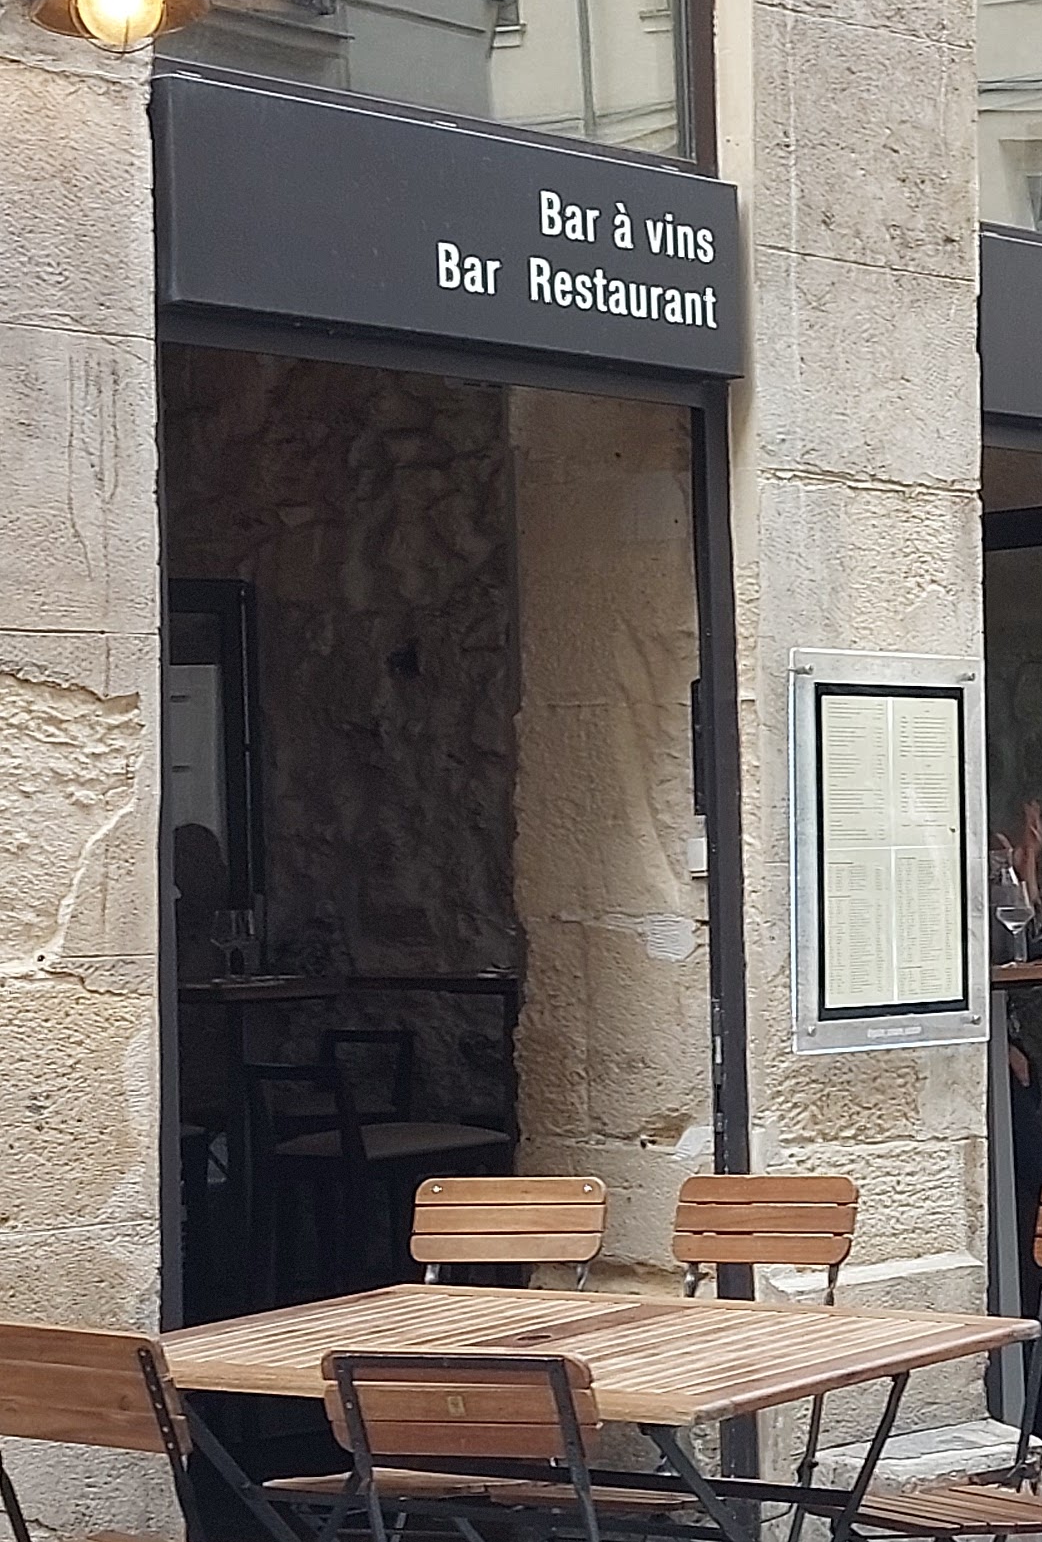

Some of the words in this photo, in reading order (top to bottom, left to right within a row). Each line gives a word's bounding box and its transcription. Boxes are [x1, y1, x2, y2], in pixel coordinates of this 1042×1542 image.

[540, 190, 600, 242] Bar
[614, 202, 634, 249] à
[645, 213, 714, 263] vins
[437, 242, 502, 295] Bar
[529, 257, 717, 329] Restaurant
